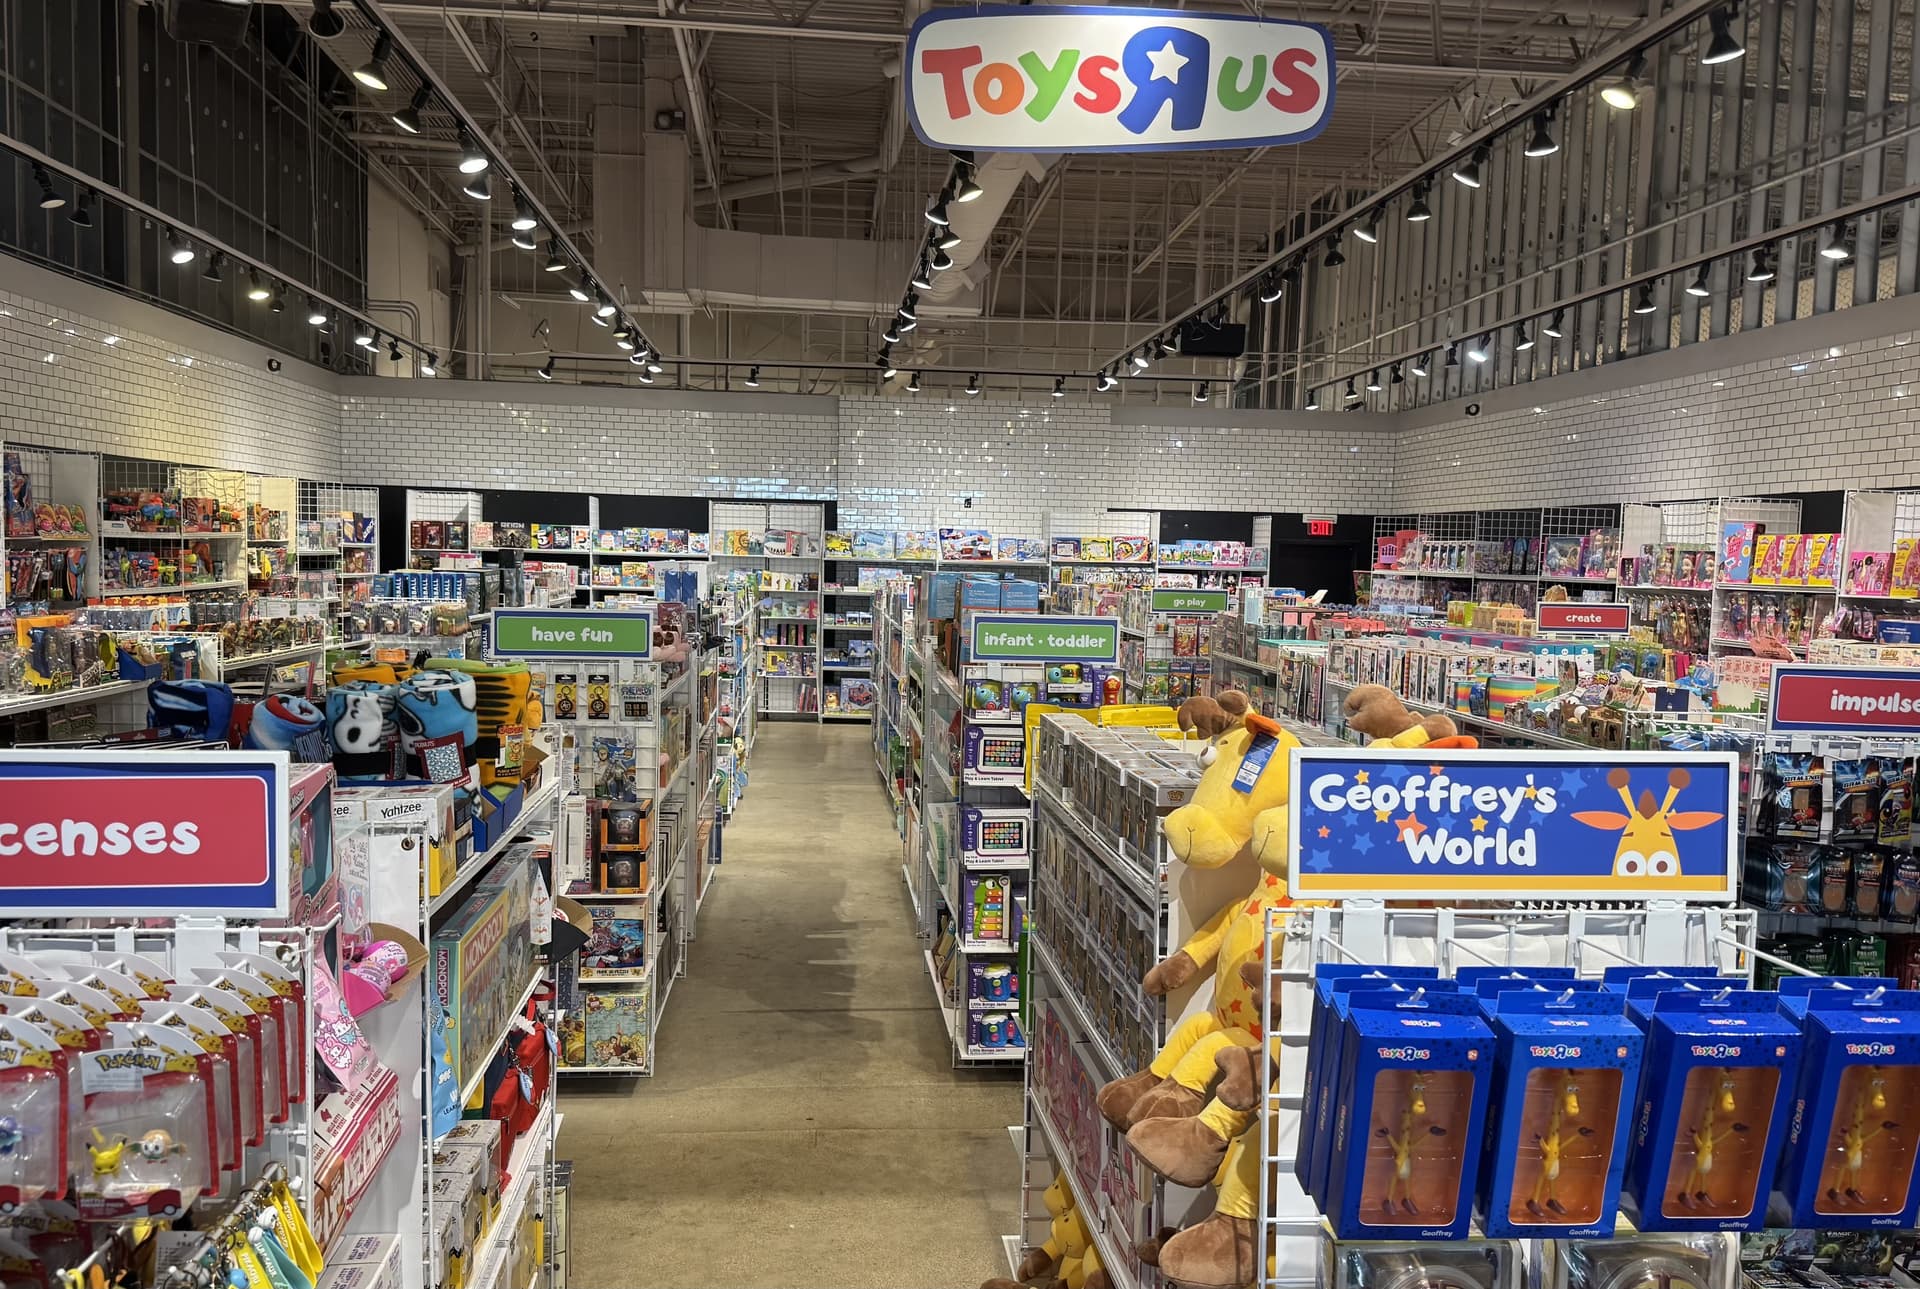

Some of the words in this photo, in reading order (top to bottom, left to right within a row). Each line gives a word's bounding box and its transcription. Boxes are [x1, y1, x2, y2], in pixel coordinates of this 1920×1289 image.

[1311, 520, 1330, 535] EXIT
[1173, 598, 1185, 606] go
[1186, 597, 1206, 608] play
[1565, 613, 1602, 623] create
[532, 626, 576, 642] have
[581, 627, 613, 643] fun
[984, 632, 1034, 647] infant
[1047, 634, 1106, 648] toddler
[1309, 773, 1557, 824] Geoffrey's
[381, 803, 422, 819] Yahtzee
[1402, 827, 1537, 867] World
[438, 950, 448, 1005] MONOPOLY
[1719, 1221, 1749, 1230] Geoffrey
[1871, 1218, 1901, 1227] Geoffrey
[1421, 1229, 1453, 1238] Geoffrey
[1568, 1228, 1600, 1237] Geoffrey
